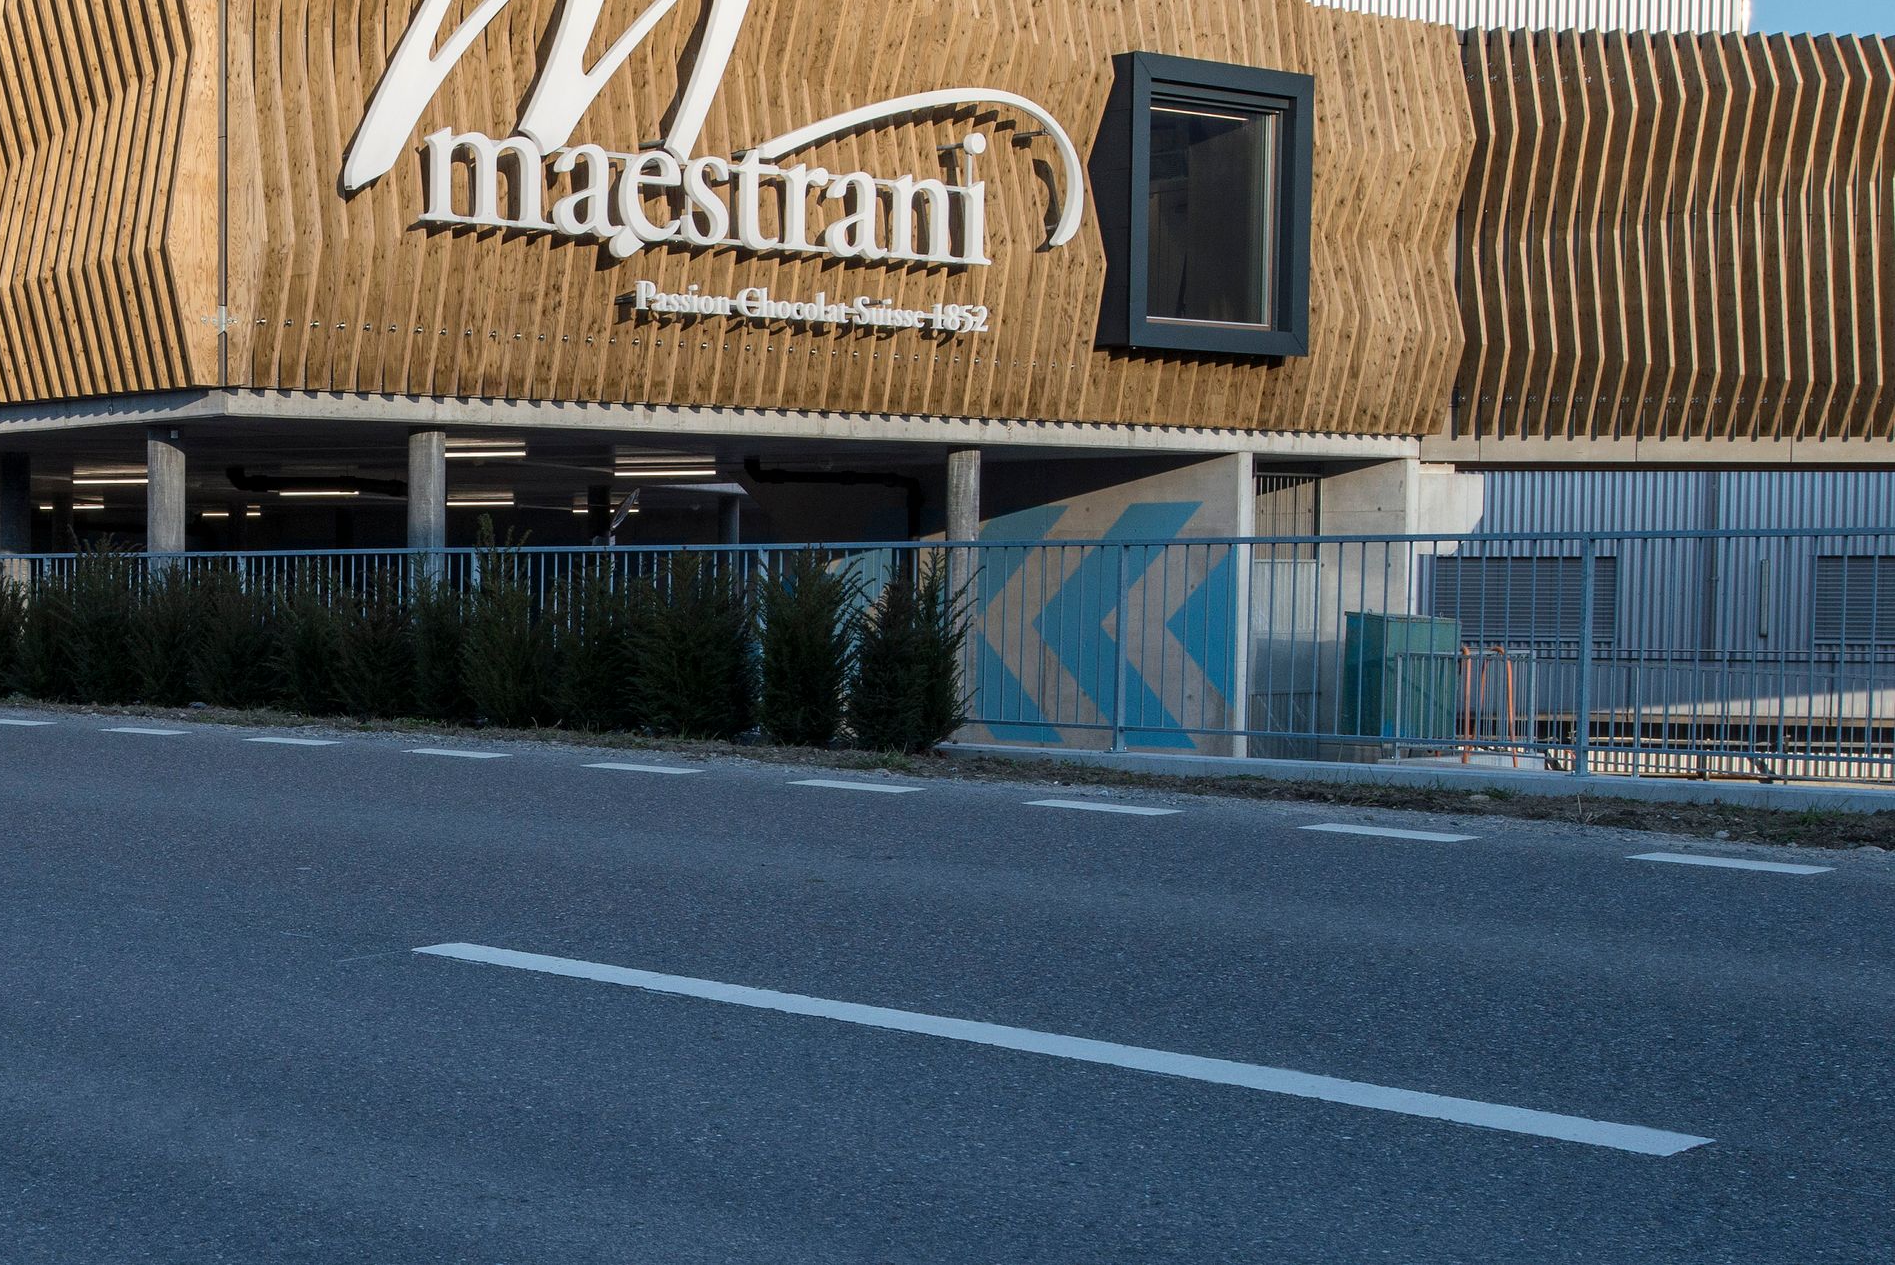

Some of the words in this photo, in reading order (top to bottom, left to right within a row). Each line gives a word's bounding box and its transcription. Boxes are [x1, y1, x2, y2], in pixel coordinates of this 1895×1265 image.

[419, 126, 992, 267] maestrani
[634, 280, 732, 316] Passion
[736, 287, 849, 323] Chocolat
[854, 296, 925, 328] Suisse
[930, 303, 989, 333] 1852
